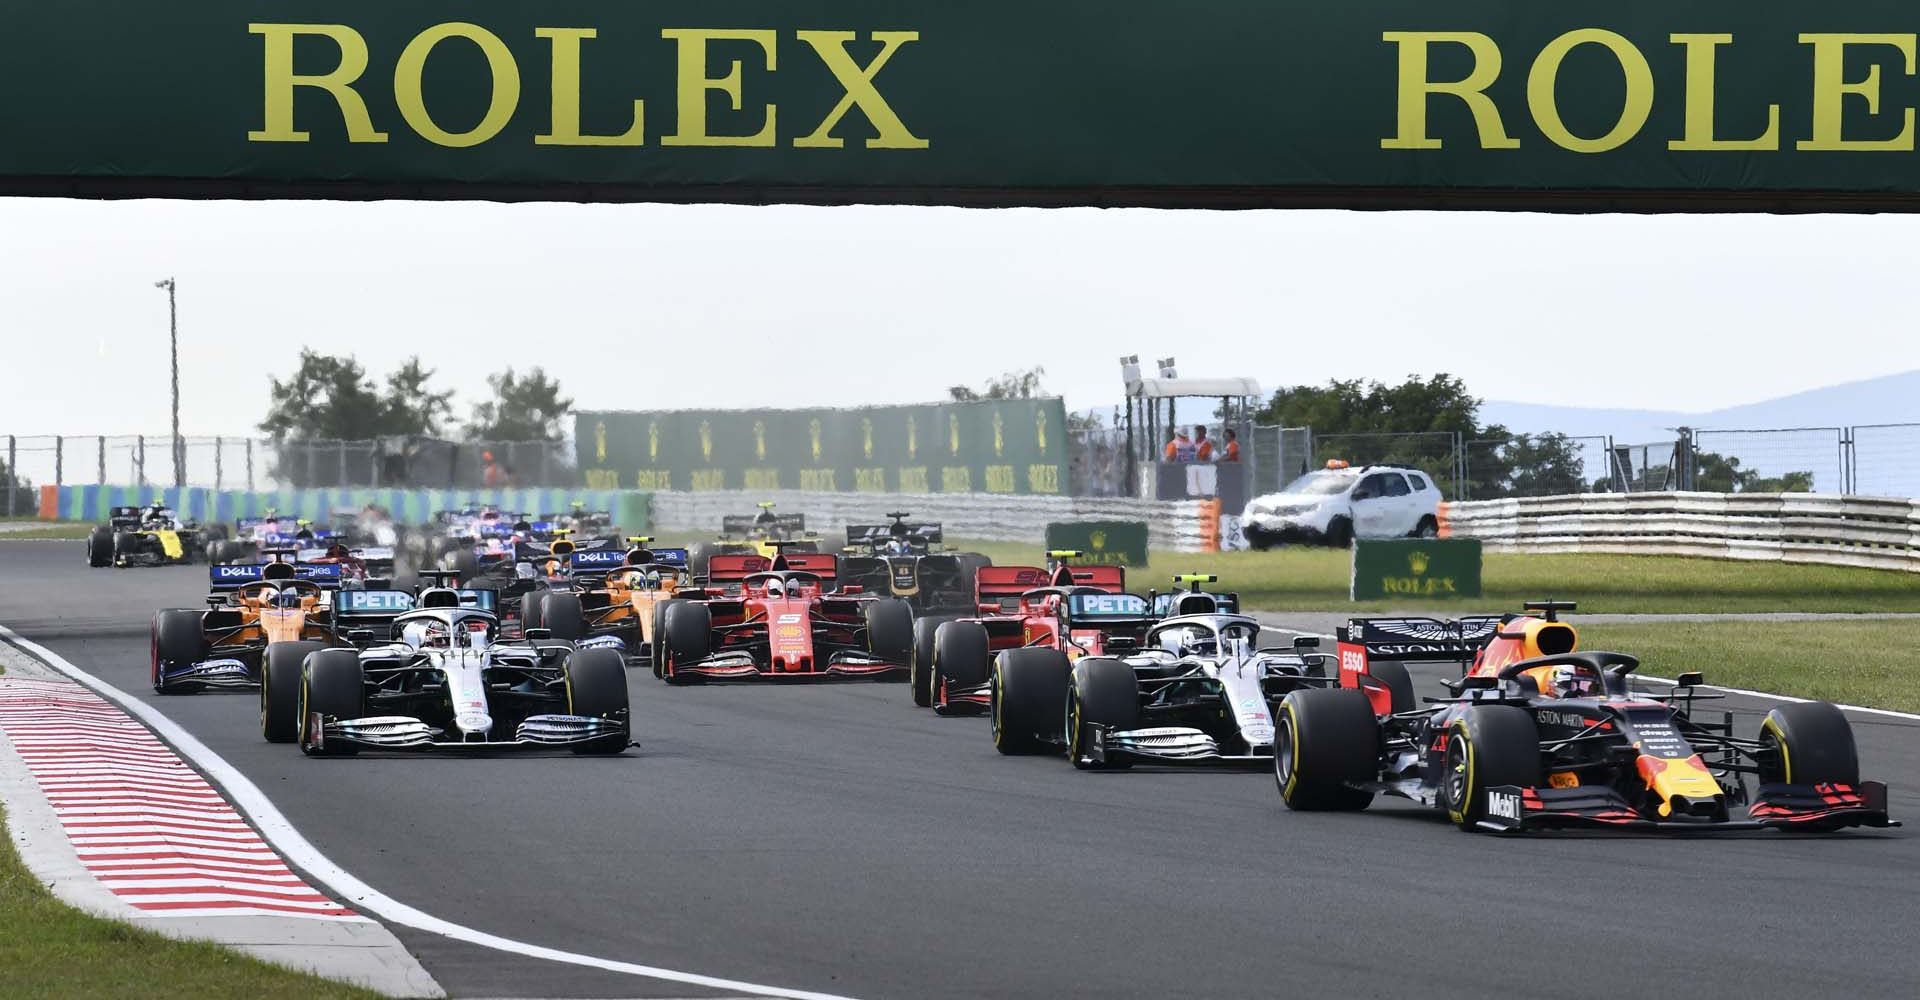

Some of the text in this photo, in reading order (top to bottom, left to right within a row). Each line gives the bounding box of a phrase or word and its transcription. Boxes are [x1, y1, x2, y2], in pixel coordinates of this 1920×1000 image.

[248, 22, 929, 149] ROLEX
[1380, 28, 1918, 153] ROLE
[578, 552, 611, 562] DELL
[220, 566, 256, 576] DELL
[776, 613, 803, 624] 5
[1342, 650, 1364, 673] ESSO
[1537, 710, 1585, 728] ASTON MARTIN
